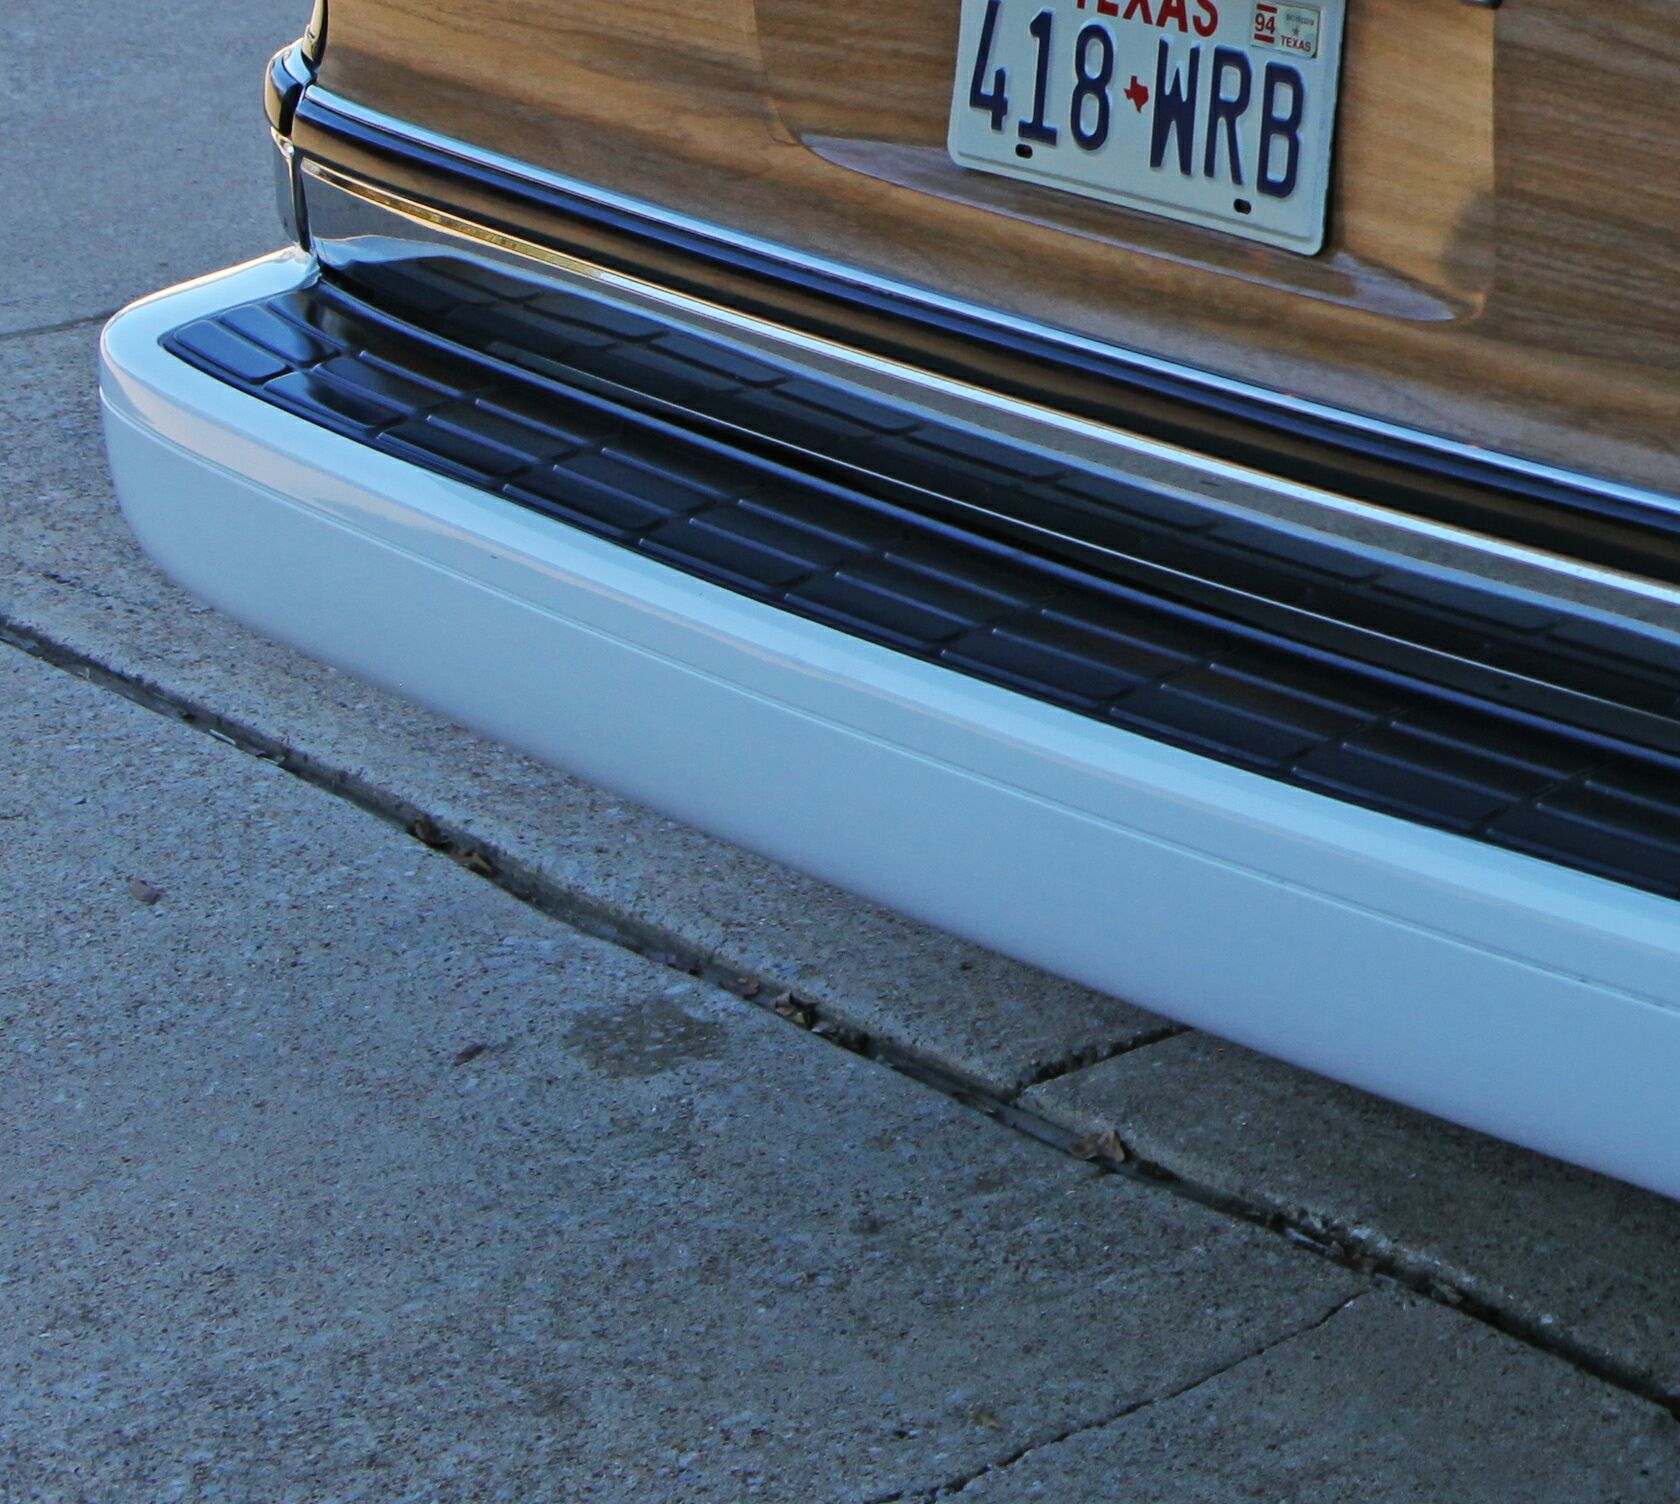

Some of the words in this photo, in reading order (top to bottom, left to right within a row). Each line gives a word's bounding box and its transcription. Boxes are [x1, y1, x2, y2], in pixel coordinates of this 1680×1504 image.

[1255, 12, 1275, 34] 94
[1280, 34, 1312, 53] TEXAS
[1149, 37, 1305, 198] WRB
